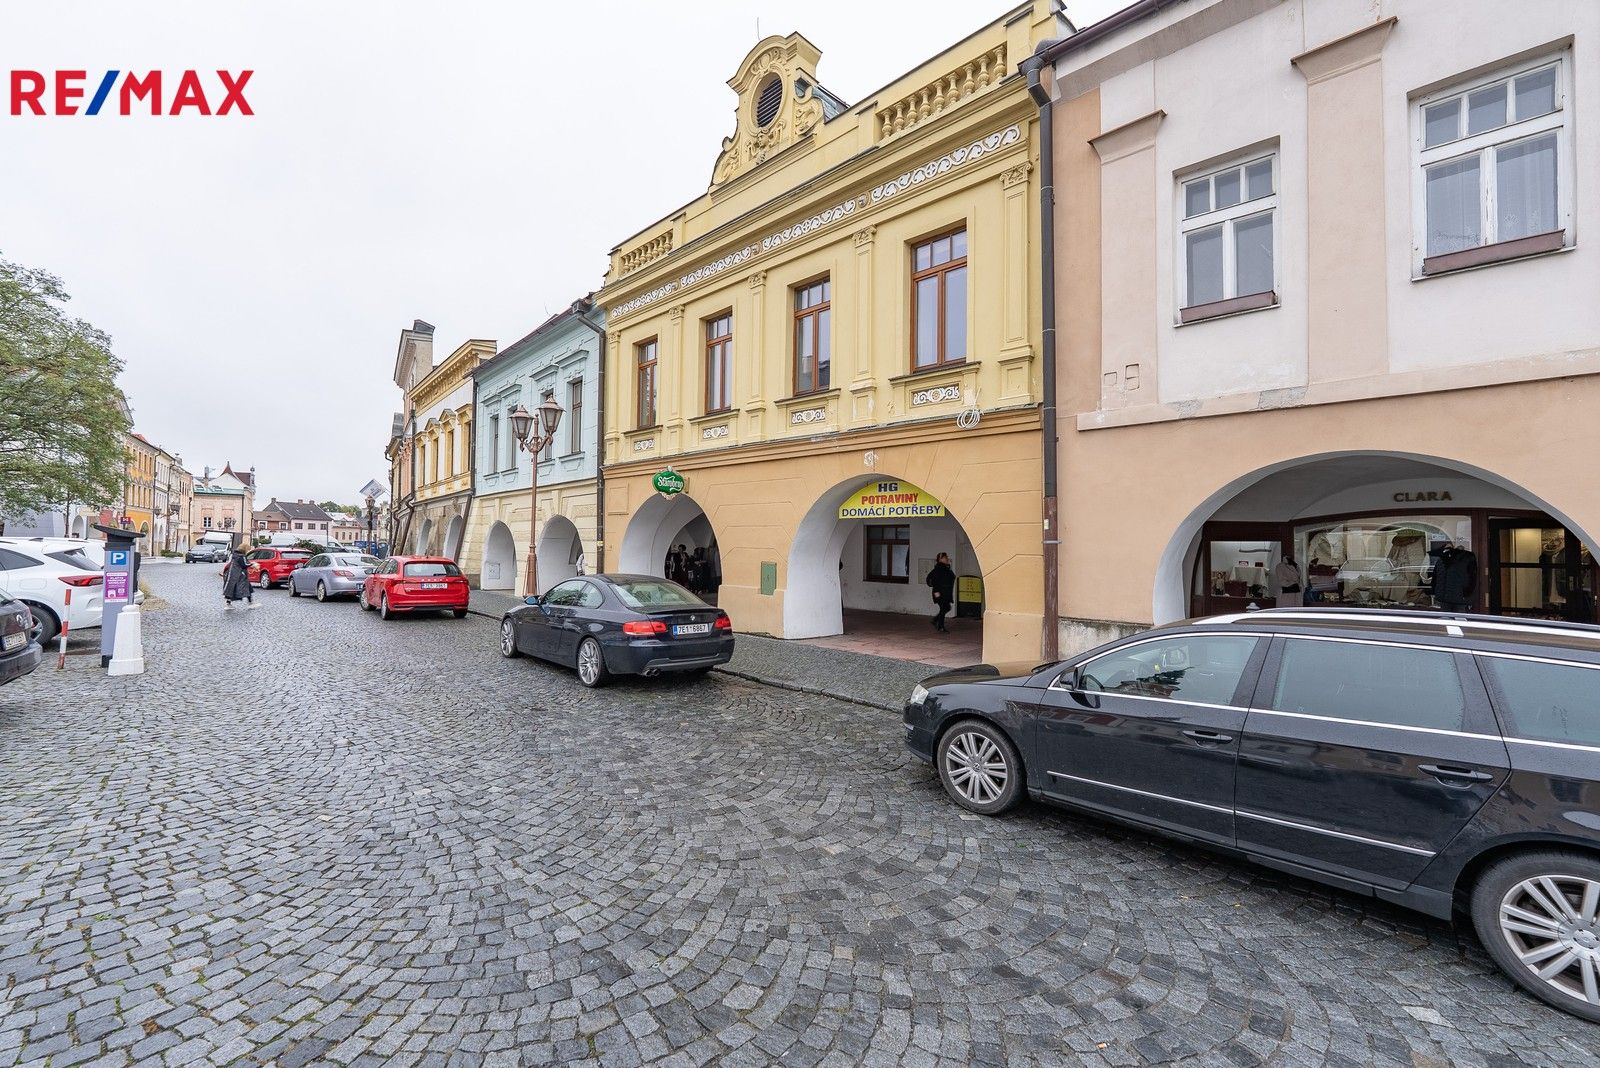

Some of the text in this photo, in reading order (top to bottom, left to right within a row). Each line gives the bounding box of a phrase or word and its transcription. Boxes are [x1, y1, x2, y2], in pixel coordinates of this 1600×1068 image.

[878, 482, 898, 492] HG
[861, 493, 919, 505] POTRAVINY
[1393, 491, 1453, 502] CLARA
[842, 504, 941, 517] DOMÁCÍ POTŘEBY
[112, 552, 125, 564] P
